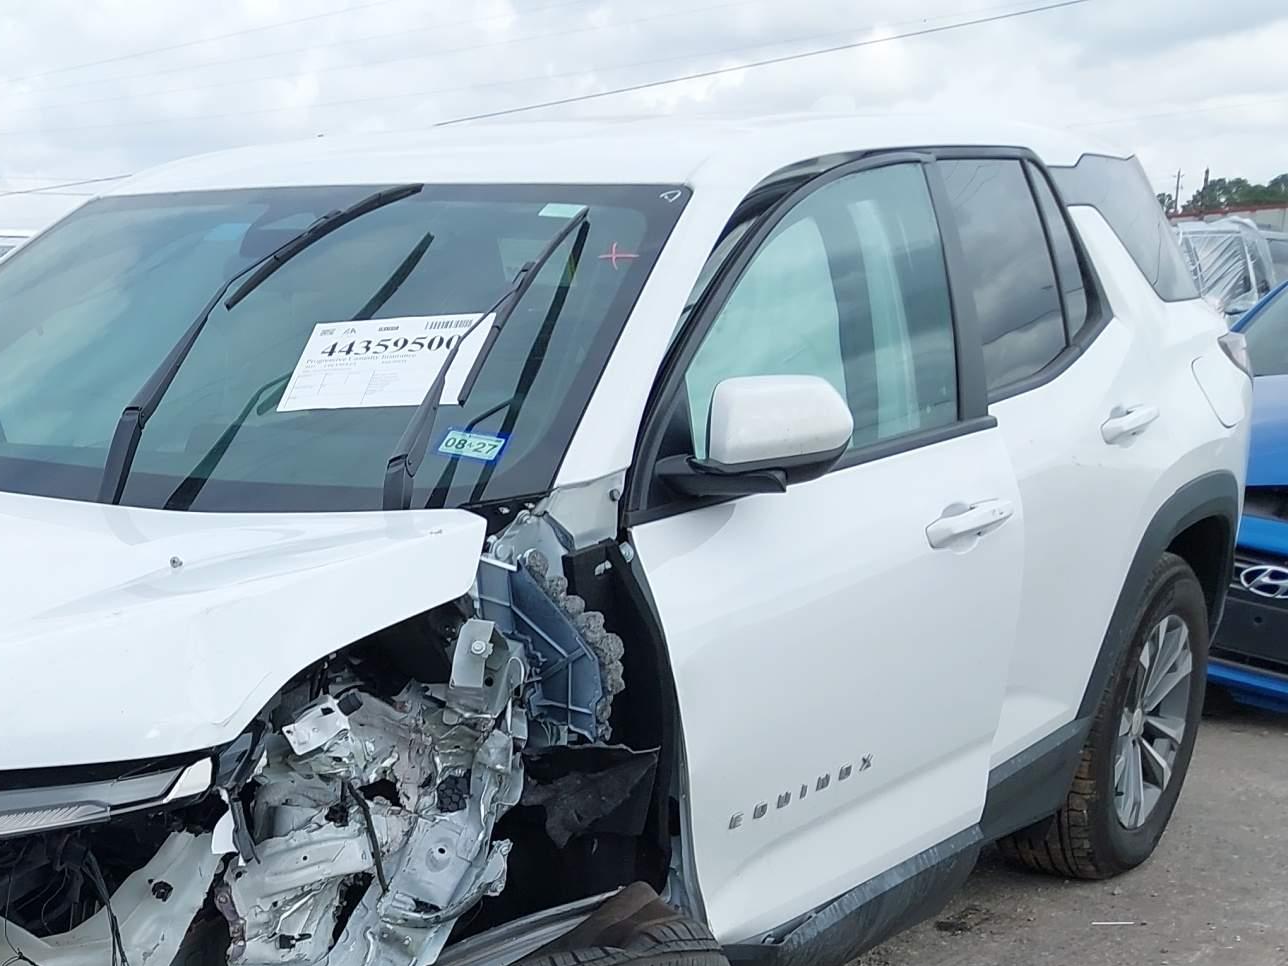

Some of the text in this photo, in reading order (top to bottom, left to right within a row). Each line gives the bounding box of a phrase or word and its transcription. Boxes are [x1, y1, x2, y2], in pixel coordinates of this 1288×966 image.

[321, 333, 462, 357] 44359500
[445, 437, 498, 454] 08 27
[728, 752, 874, 830] EQUINOX
